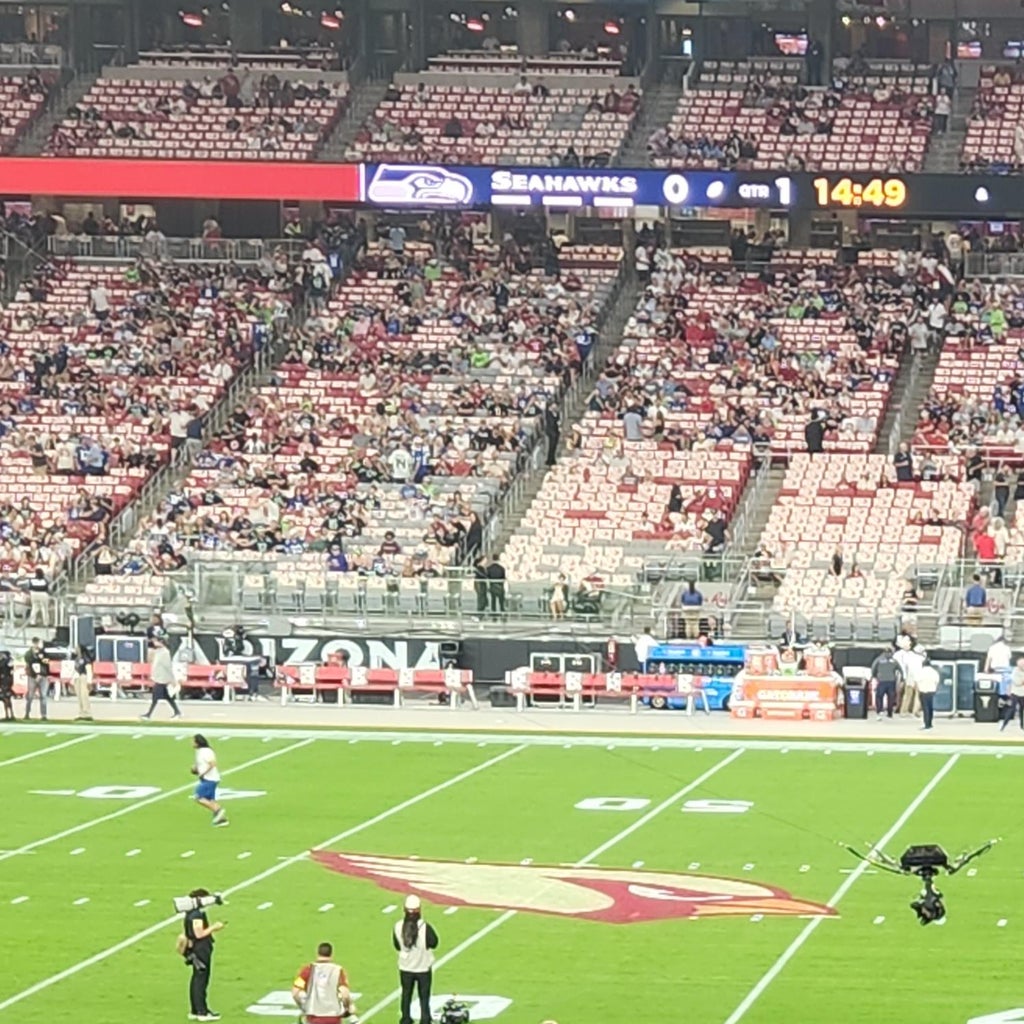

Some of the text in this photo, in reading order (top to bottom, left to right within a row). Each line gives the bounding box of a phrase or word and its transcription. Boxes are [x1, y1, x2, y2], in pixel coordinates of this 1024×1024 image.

[491, 171, 637, 192] SEAHAWKS
[663, 174, 689, 204] 0
[775, 177, 790, 205] 1
[814, 178, 906, 207] 14:49
